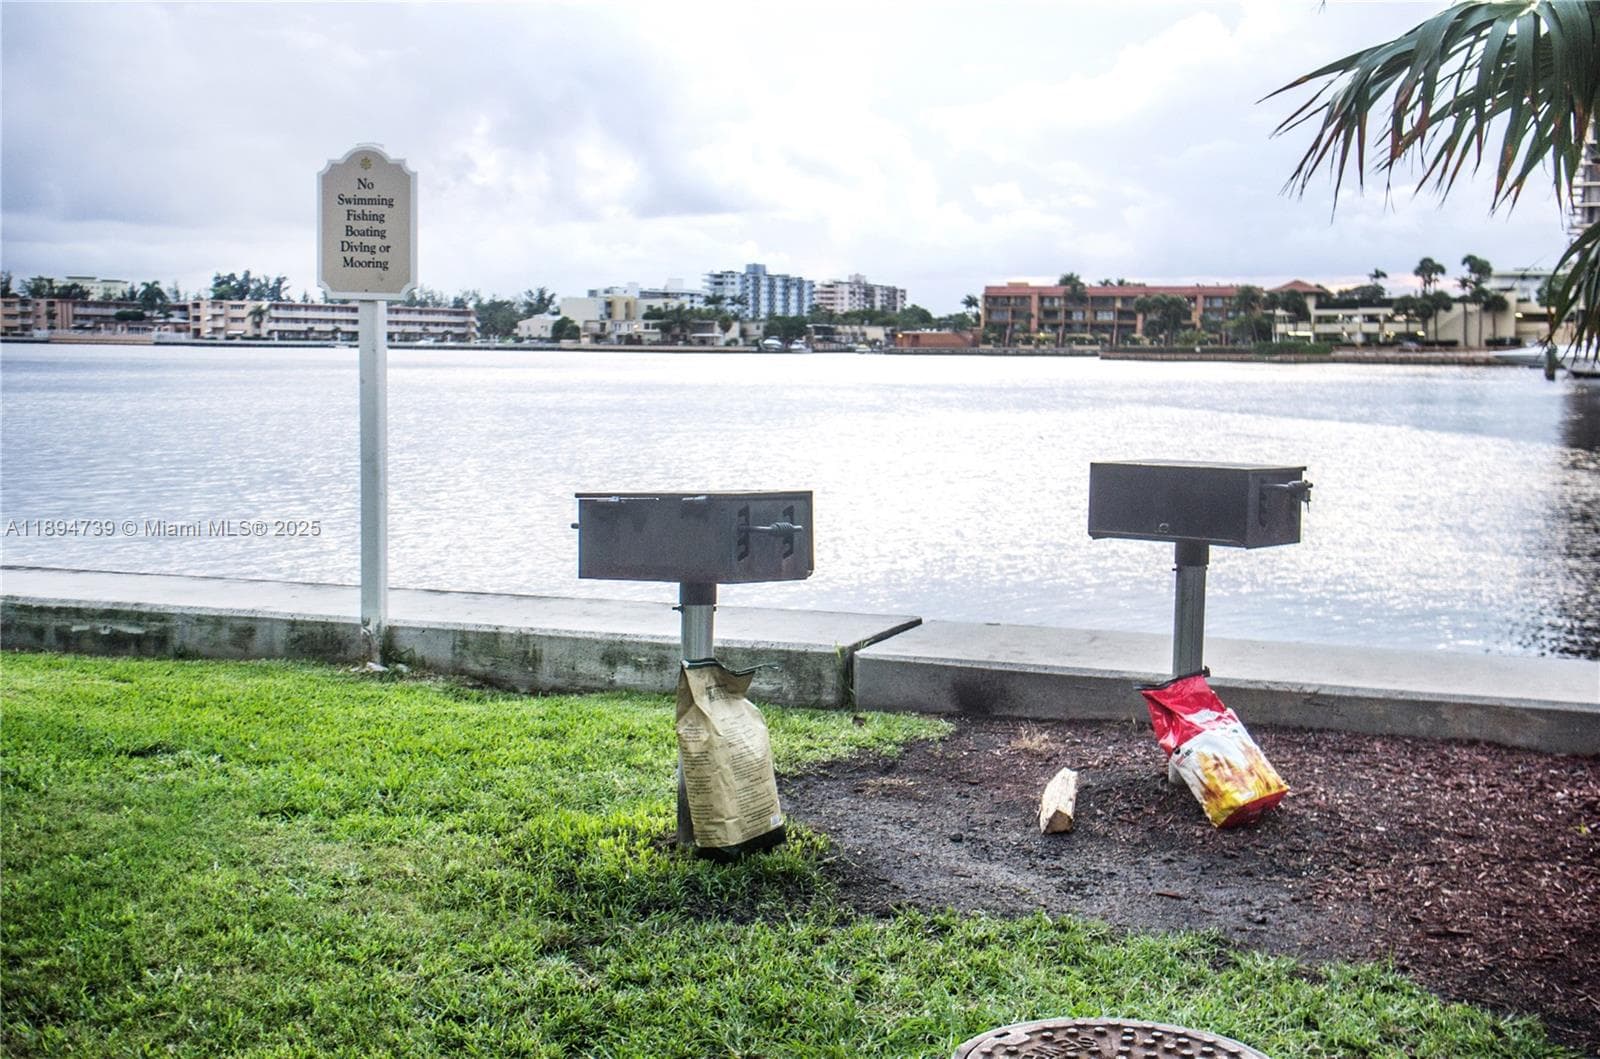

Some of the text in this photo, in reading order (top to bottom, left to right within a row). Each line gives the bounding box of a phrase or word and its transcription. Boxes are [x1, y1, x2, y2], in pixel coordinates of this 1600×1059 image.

[357, 178, 374, 190] No
[337, 193, 394, 208] Swimming
[346, 209, 385, 224] Fishing
[345, 225, 386, 240] Boating
[340, 241, 391, 255] Diving or
[343, 256, 389, 271] Mooring
